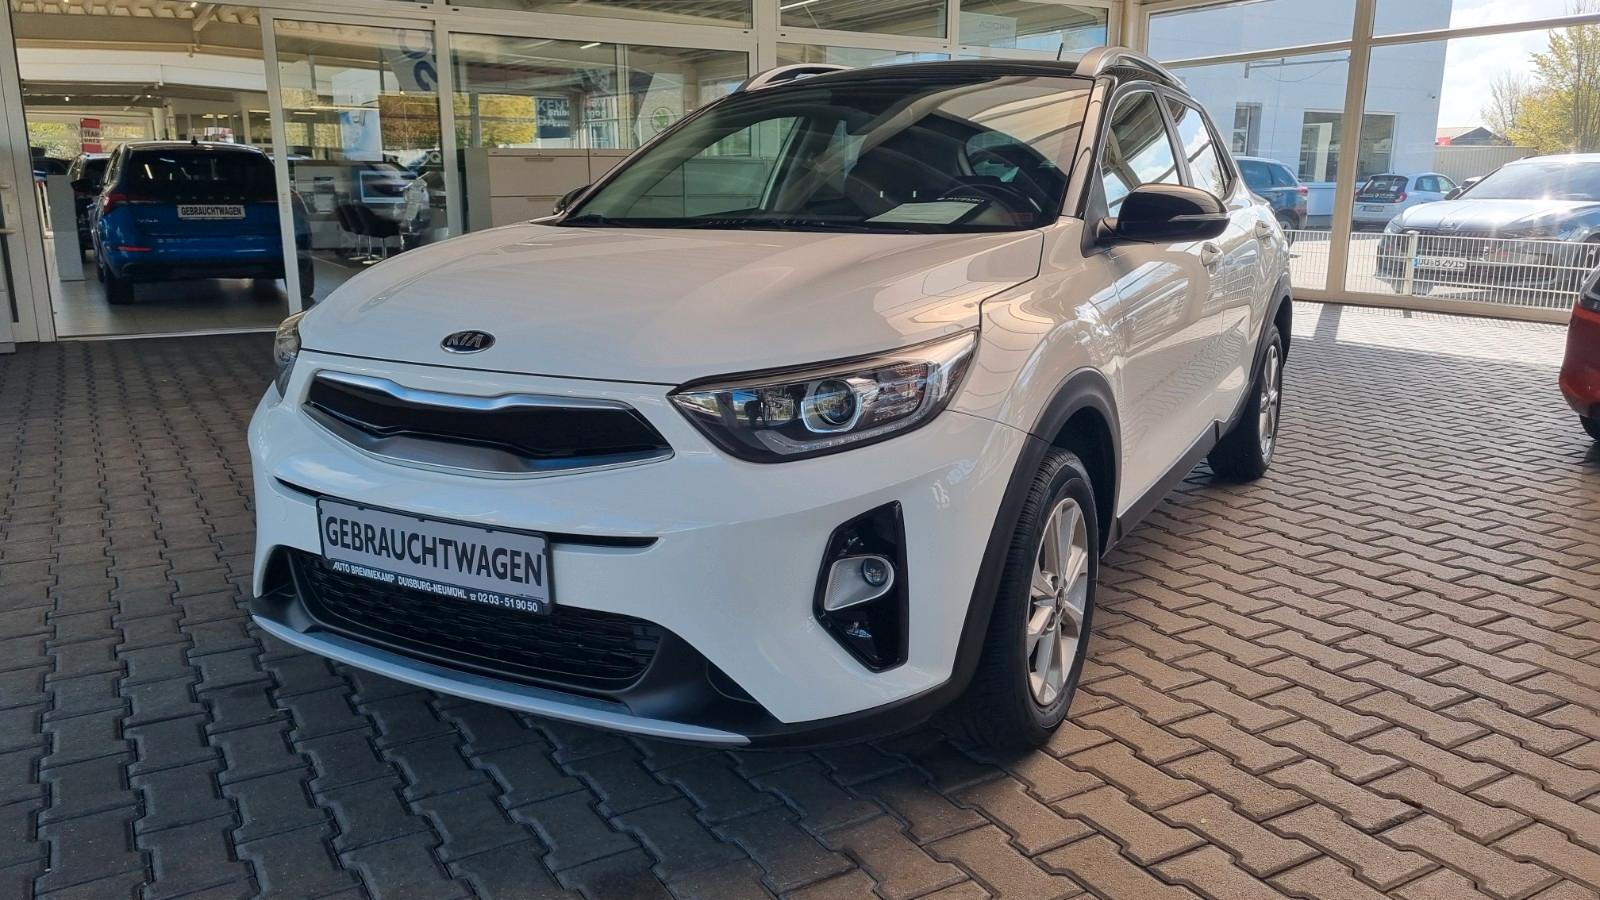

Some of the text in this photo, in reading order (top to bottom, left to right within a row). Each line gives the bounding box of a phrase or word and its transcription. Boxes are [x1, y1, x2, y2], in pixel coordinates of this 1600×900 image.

[180, 206, 242, 216] GEBRAUCHTWAGEN
[446, 332, 484, 348] KIA
[325, 515, 541, 586] GEBRAUCHTWAGEN
[332, 561, 350, 573] AUTO
